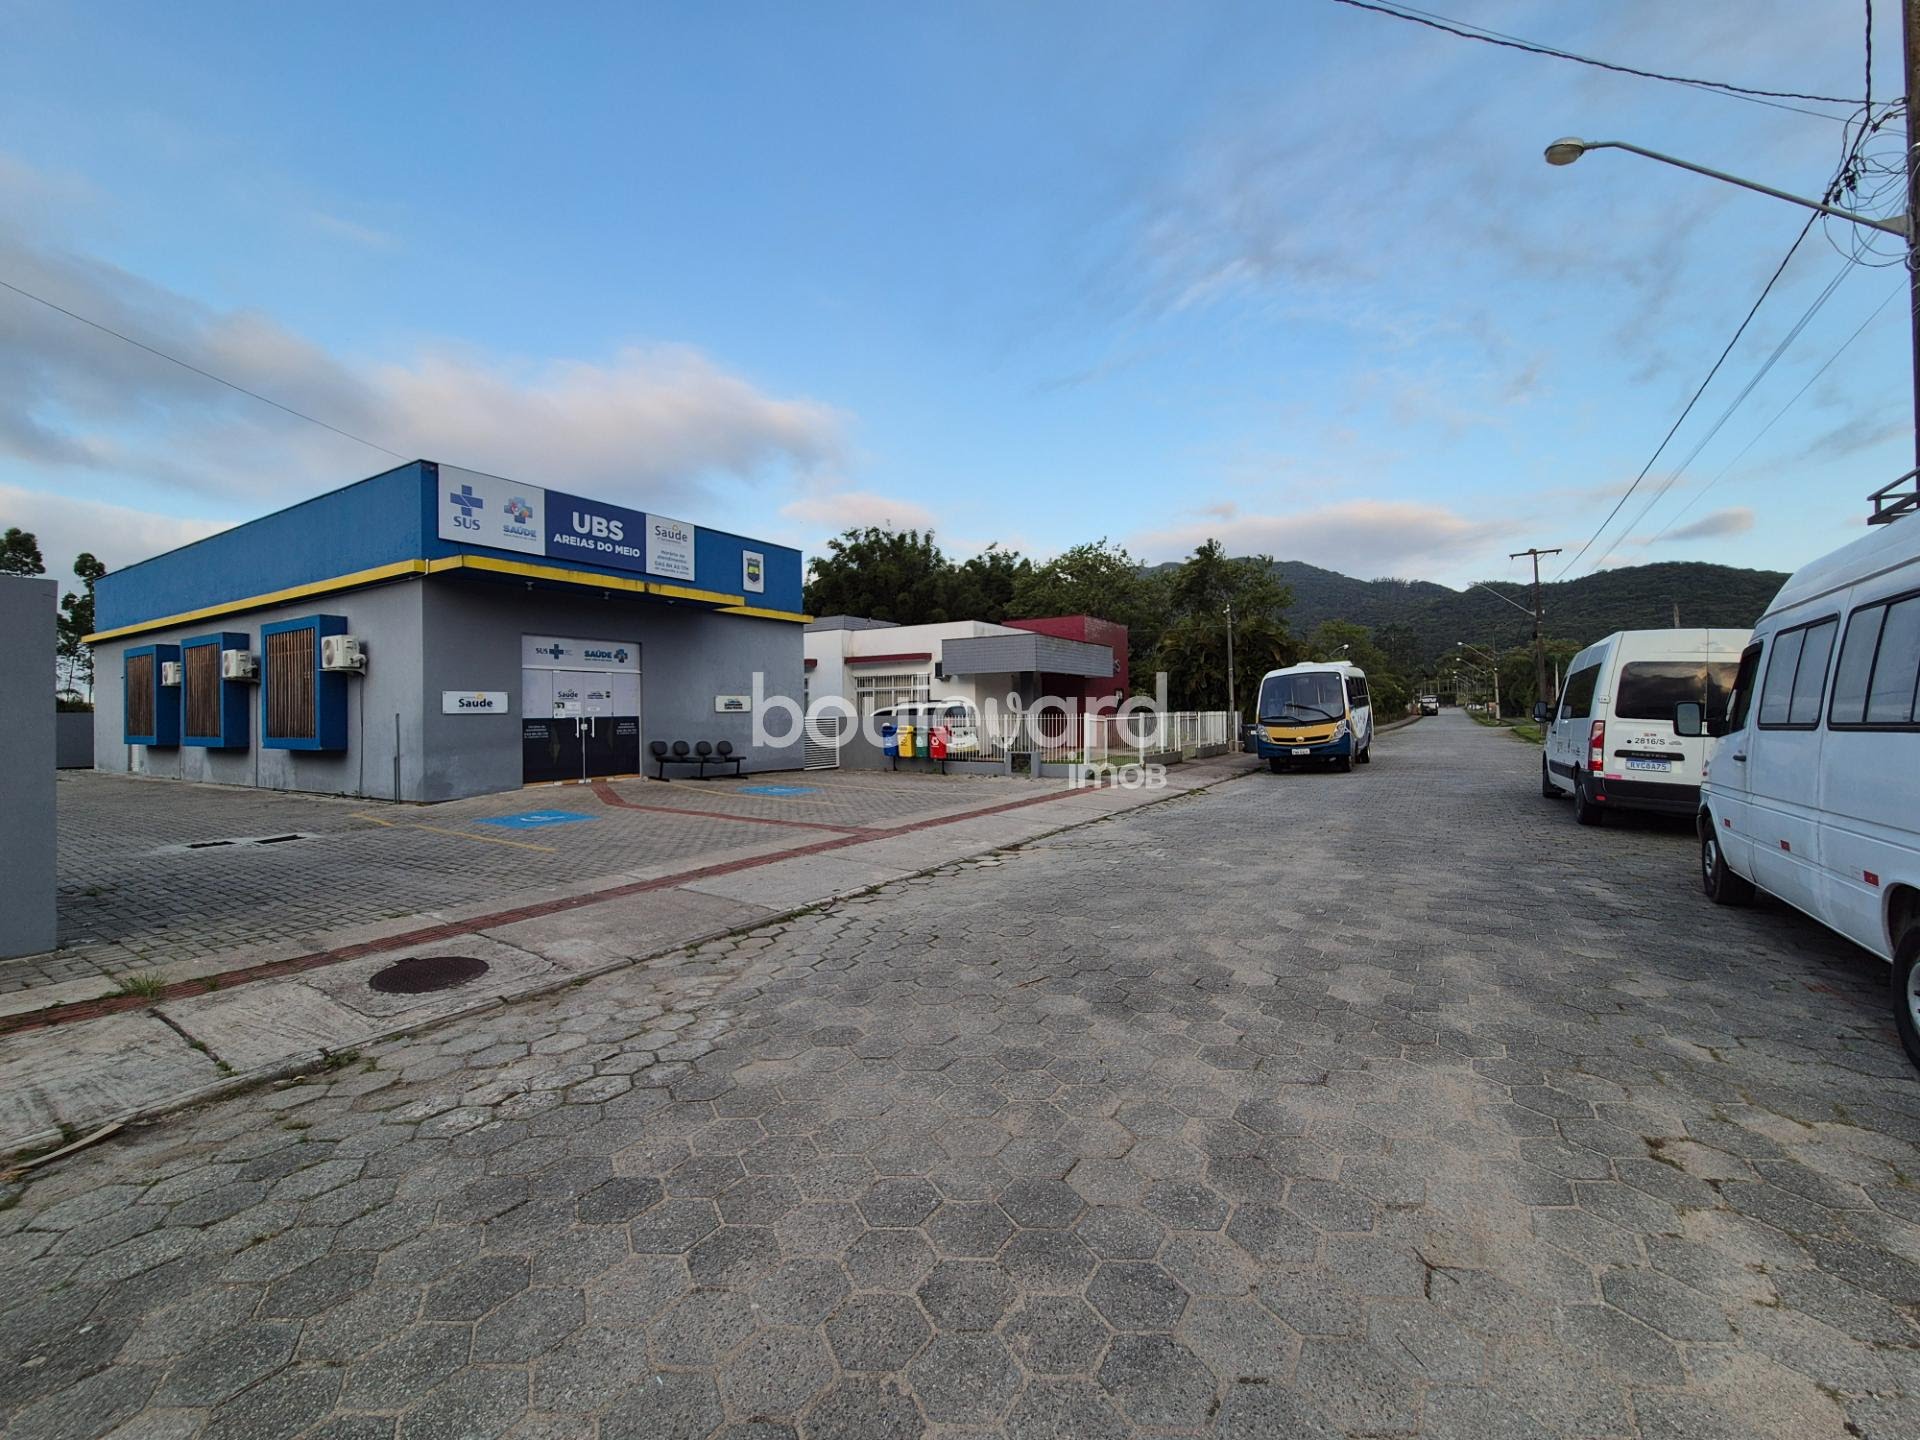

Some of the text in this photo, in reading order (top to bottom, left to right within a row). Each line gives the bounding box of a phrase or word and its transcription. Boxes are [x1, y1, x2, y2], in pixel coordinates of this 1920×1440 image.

[452, 515, 481, 531] SUS
[573, 511, 624, 541] UBS
[553, 533, 641, 557] AREIAS DO MEIO
[584, 649, 612, 659] SAÚDE
